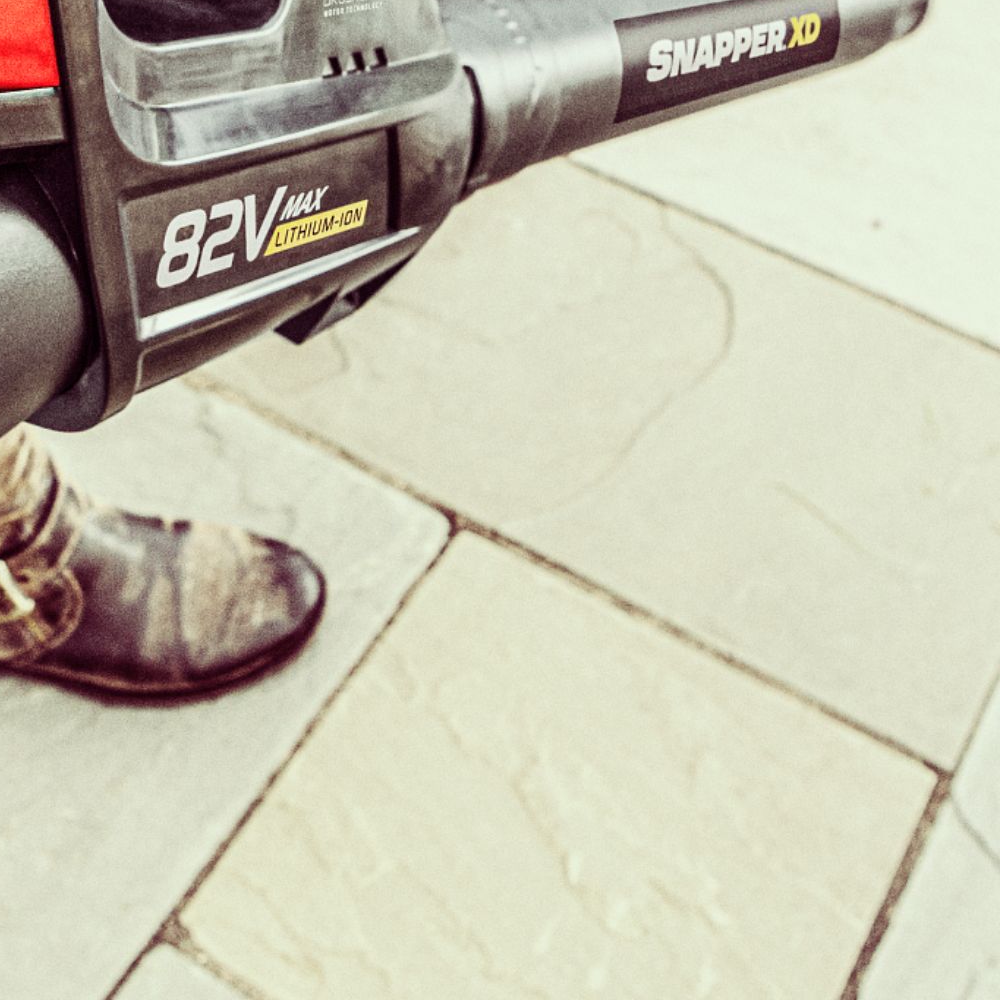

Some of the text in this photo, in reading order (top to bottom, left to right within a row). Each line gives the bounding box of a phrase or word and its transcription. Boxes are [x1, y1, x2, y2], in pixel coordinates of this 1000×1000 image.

[788, 12, 822, 49] XD
[156, 185, 330, 289] 82V MAX
[275, 206, 364, 248] LITHIUM-ION
